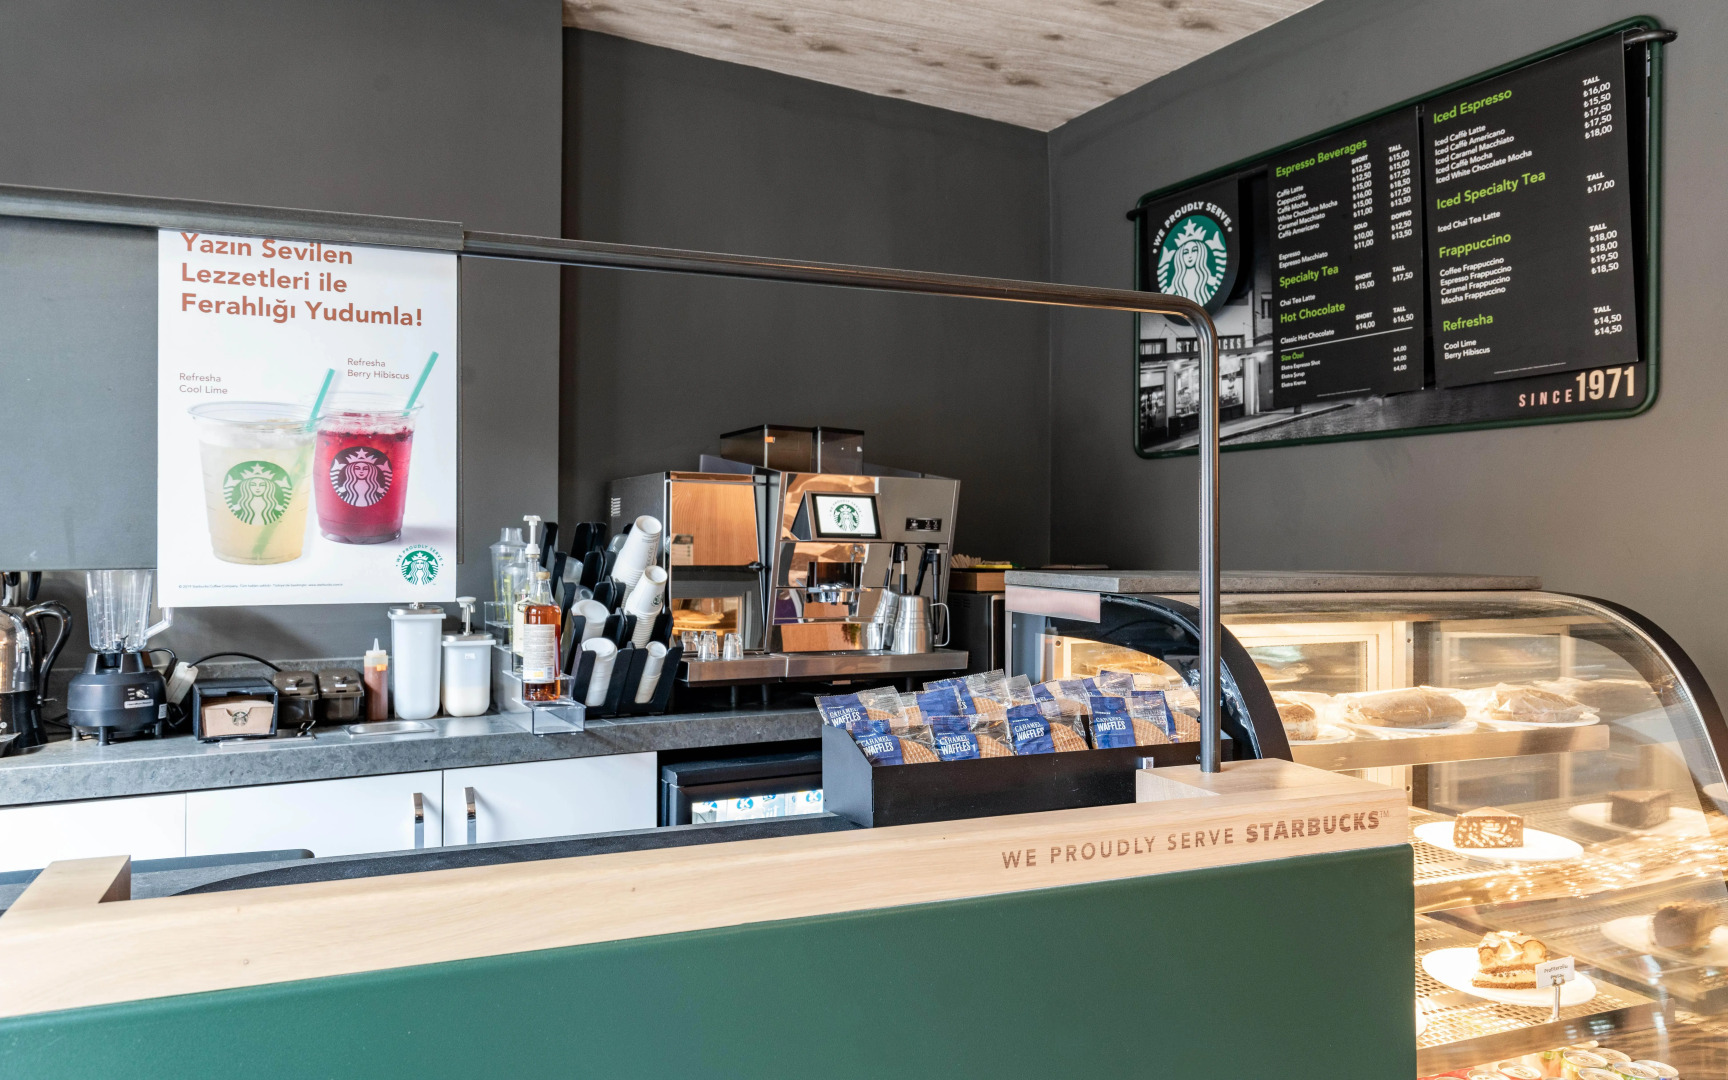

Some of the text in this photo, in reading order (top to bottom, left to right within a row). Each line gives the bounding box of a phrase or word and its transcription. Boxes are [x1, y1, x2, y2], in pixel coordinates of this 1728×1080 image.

[1583, 76, 1600, 86] TALL
[1434, 90, 1512, 123] Iced Espresso
[1435, 136, 1448, 146] Iced
[1468, 126, 1486, 135] Latte
[1435, 145, 1449, 156] Iced
[1469, 129, 1505, 145] Americano
[1388, 144, 1402, 152] TALL
[1436, 136, 1514, 165] Iced Caramel Macchiato
[1276, 140, 1367, 177] Espresso Beverages
[1352, 155, 1368, 164] SHORT
[1436, 164, 1450, 174] Iced
[1470, 153, 1492, 164] Mocha
[1436, 150, 1532, 184] Iced White Chocolate Mocha
[1587, 172, 1604, 181] TALL
[1437, 172, 1545, 209] Iced Specialty Tea
[1277, 194, 1306, 206] Cappuccino
[1290, 201, 1308, 210] Mocha
[1293, 206, 1319, 218] Chocolate
[1320, 200, 1338, 210] Mocha
[1391, 210, 1412, 220] DOPPIO
[1153, 201, 1232, 246] WE PROUDLY SERVE
[1278, 213, 1325, 230] Caramel Macchiato
[1354, 222, 1368, 230] SOLO
[1438, 222, 1452, 232] Iced
[1453, 219, 1468, 228] Chai
[1483, 212, 1500, 220] Latte
[1589, 223, 1607, 232] TALL
[1292, 224, 1319, 234] Americano
[180, 232, 353, 264] Yazın Sevilen
[1440, 234, 1511, 258] Frappuccino
[1279, 251, 1300, 260] Espresso
[1279, 252, 1328, 268] Espresso Macchiato
[1440, 258, 1504, 276] Coffee Frappuccino
[182, 263, 347, 292] Lezzetleri ile
[1280, 266, 1338, 288] Specialty Tea
[1355, 272, 1372, 281] SHORT
[1440, 266, 1512, 286] Espresso Frappuccino
[1441, 276, 1510, 295] Caramel Frappuccino
[1442, 287, 1506, 304] Mocha Frappuccino
[182, 293, 422, 326] Ferahlığı Yudumla!
[1281, 304, 1345, 323] Hot Chocolate
[1356, 312, 1372, 320] SHORT
[1443, 314, 1493, 331] Refresha
[1308, 330, 1334, 339] Chocolate
[1444, 341, 1459, 350] Cool
[1463, 348, 1490, 356] Hibiscus
[348, 358, 385, 367] Refresha
[180, 373, 221, 382] Refresha
[348, 369, 409, 379] Berry Hibiscus
[179, 385, 228, 394] Cool Lime
[1519, 389, 1572, 407] SINCE
[1576, 366, 1635, 402] 1971
[829, 707, 858, 719] CARAMEL
[831, 712, 861, 726] WAFFLES
[1014, 722, 1044, 732] CARAMEL
[1097, 721, 1126, 732] WAFFLES
[861, 735, 891, 747] CARAMEL
[939, 735, 969, 745] CARAMEL
[1016, 728, 1044, 741] WAFFLES
[863, 742, 894, 756] WAFFLES
[941, 741, 971, 755] WAFFLES
[1002, 848, 1036, 869] WE
[1050, 836, 1156, 864] PROUDLY
[1167, 828, 1233, 850] SERVE
[1246, 810, 1379, 843] STARBUCKS
